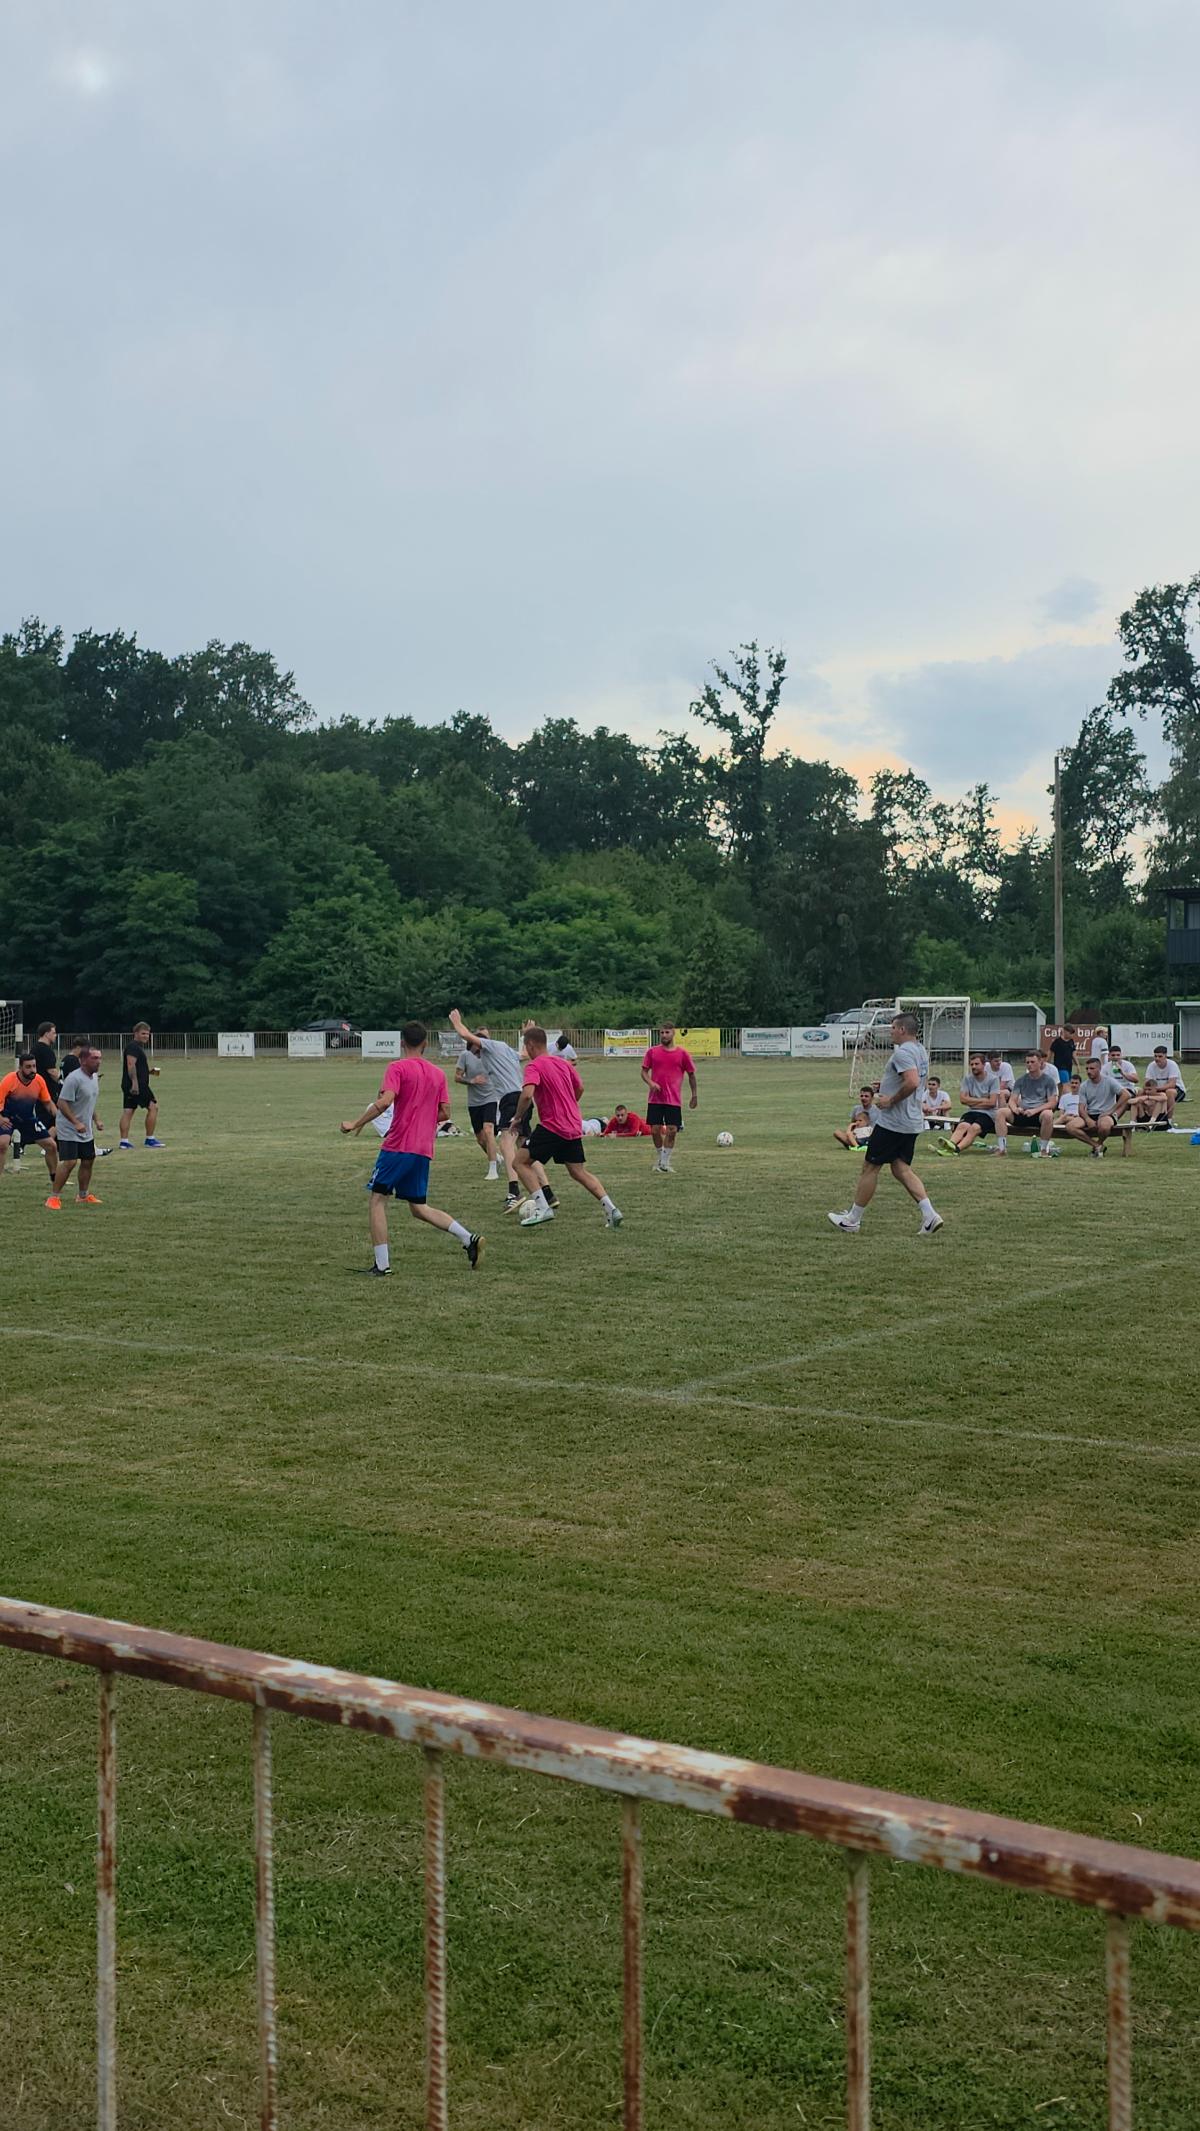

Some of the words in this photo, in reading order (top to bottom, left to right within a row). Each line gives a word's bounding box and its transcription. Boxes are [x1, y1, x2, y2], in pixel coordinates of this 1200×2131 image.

[1044, 1027, 1063, 1038] Caf
[1077, 1027, 1095, 1038] bar
[1135, 1031, 1149, 1039] Tim
